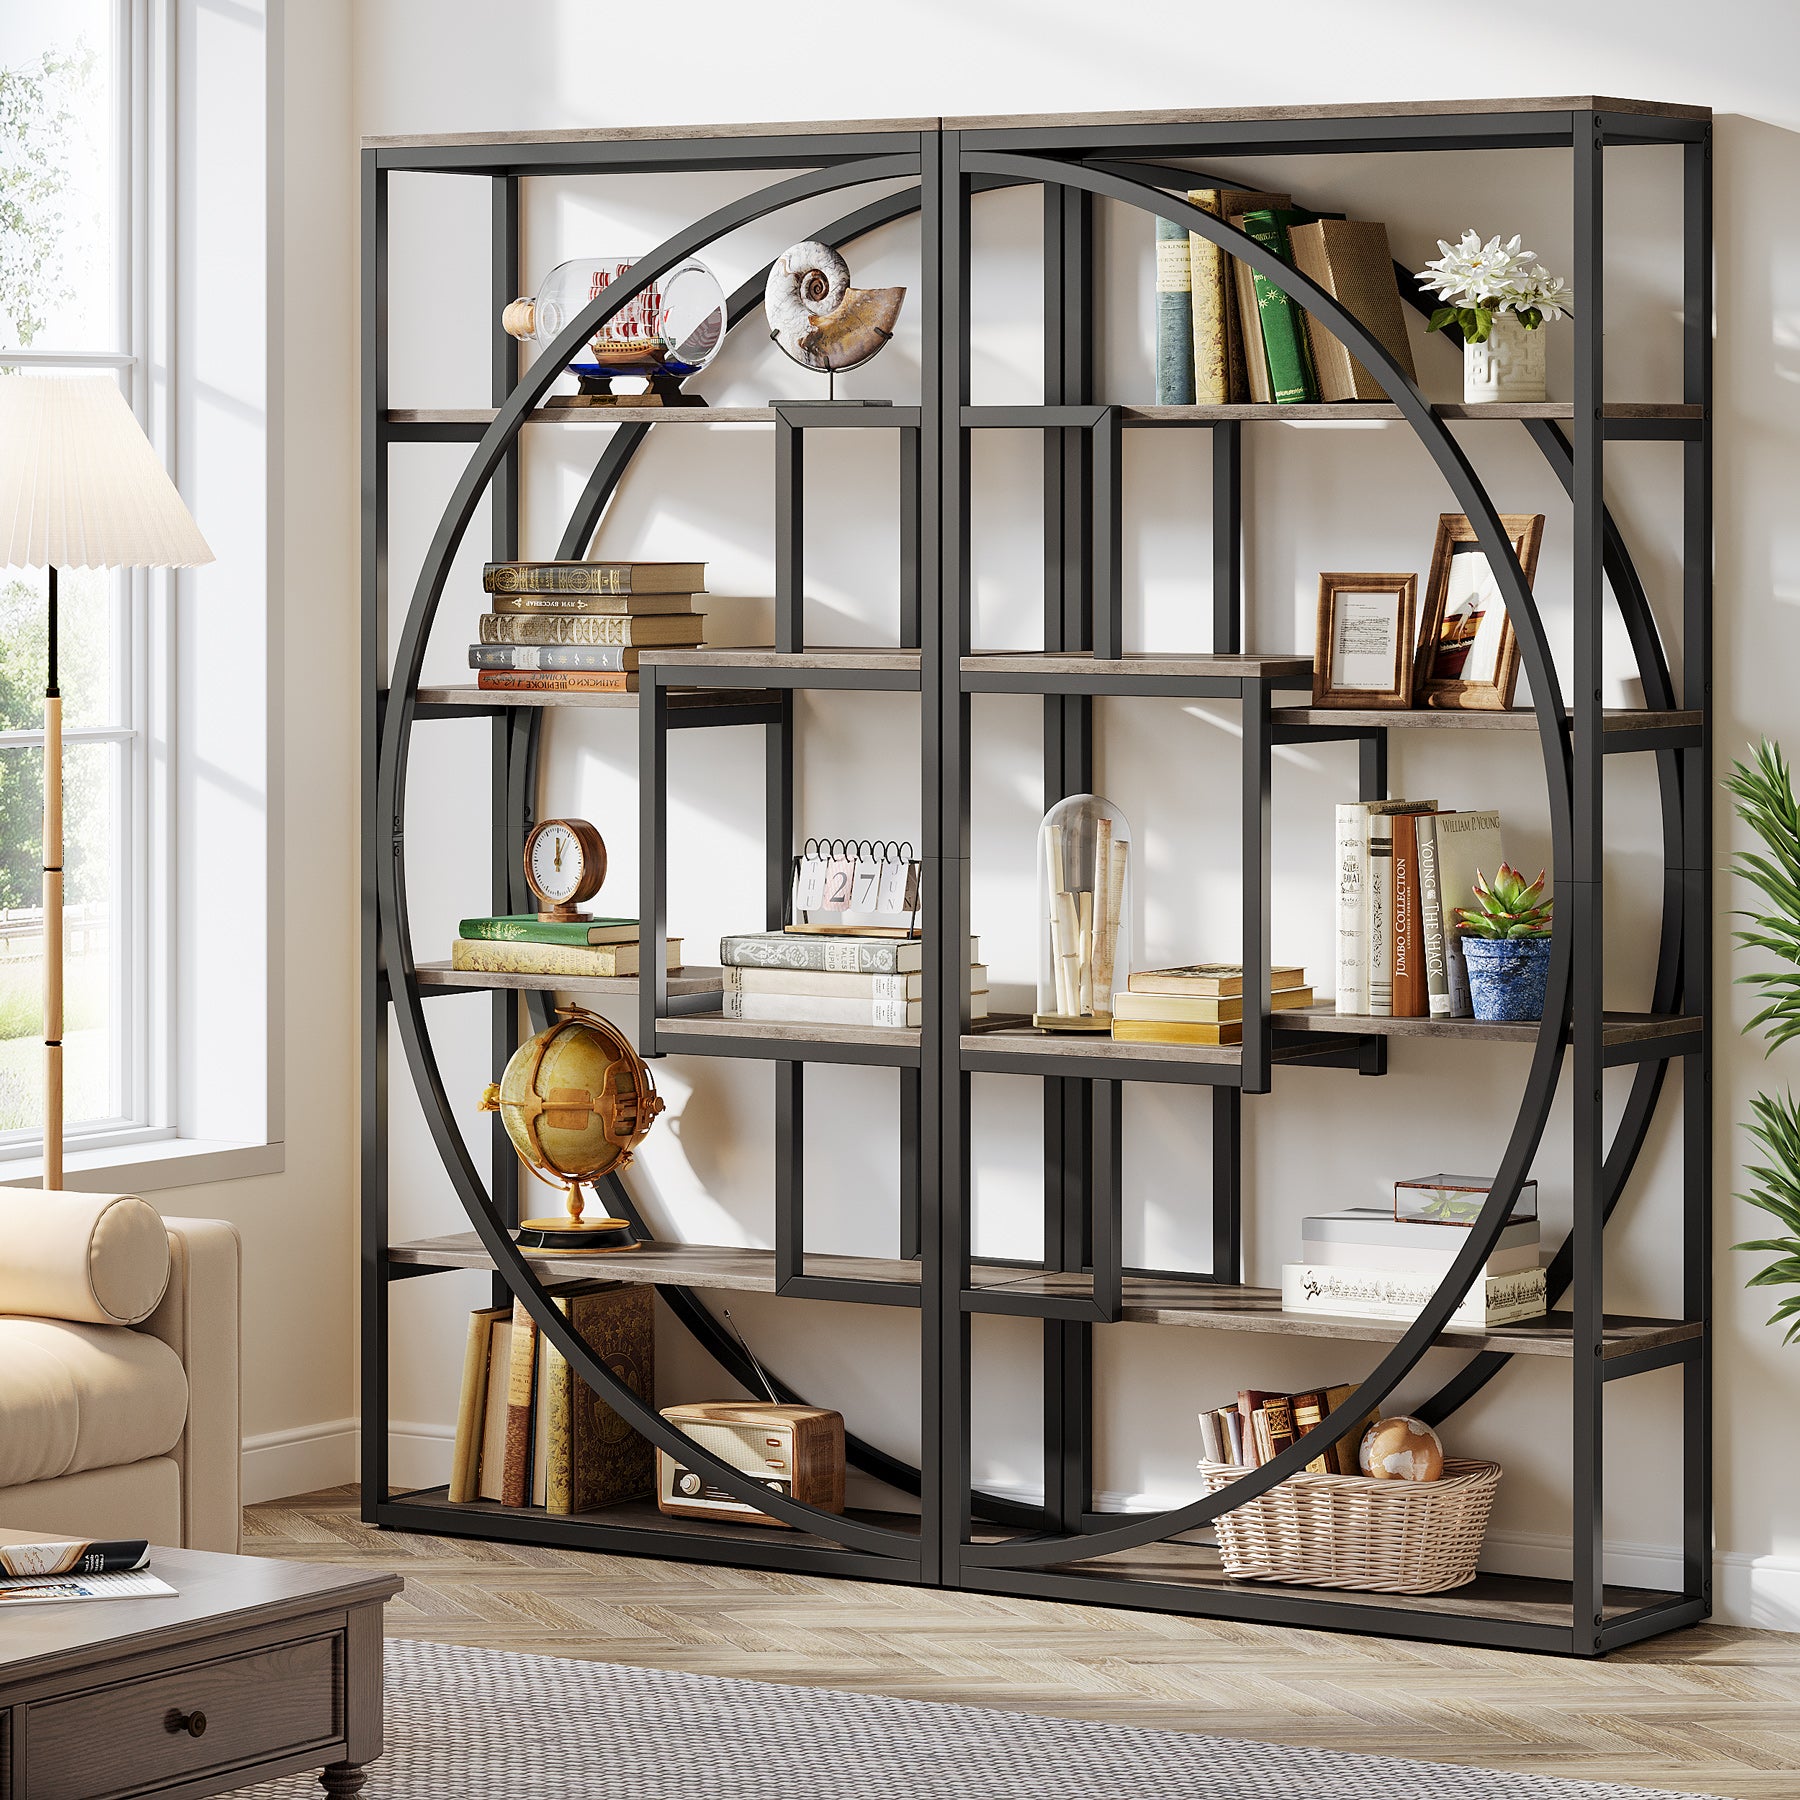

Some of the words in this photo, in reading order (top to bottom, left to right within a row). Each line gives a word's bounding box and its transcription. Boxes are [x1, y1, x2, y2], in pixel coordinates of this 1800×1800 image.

[526, 680, 568, 690] ШЕРЛОКЕ
[576, 678, 620, 688] ЗАПИСКИ
[1442, 819, 1471, 833] WILLIAM
[1471, 816, 1477, 831] P.
[1477, 815, 1501, 830] YOUNG
[1421, 839, 1437, 889] YOUNG
[1395, 857, 1407, 933] COLLECTION
[1424, 902, 1440, 929] THE
[828, 945, 836, 970] CUPID
[1395, 936, 1409, 978] JUMBO
[1426, 933, 1445, 979] SHACK
[1455, 987, 1470, 1009] TH
